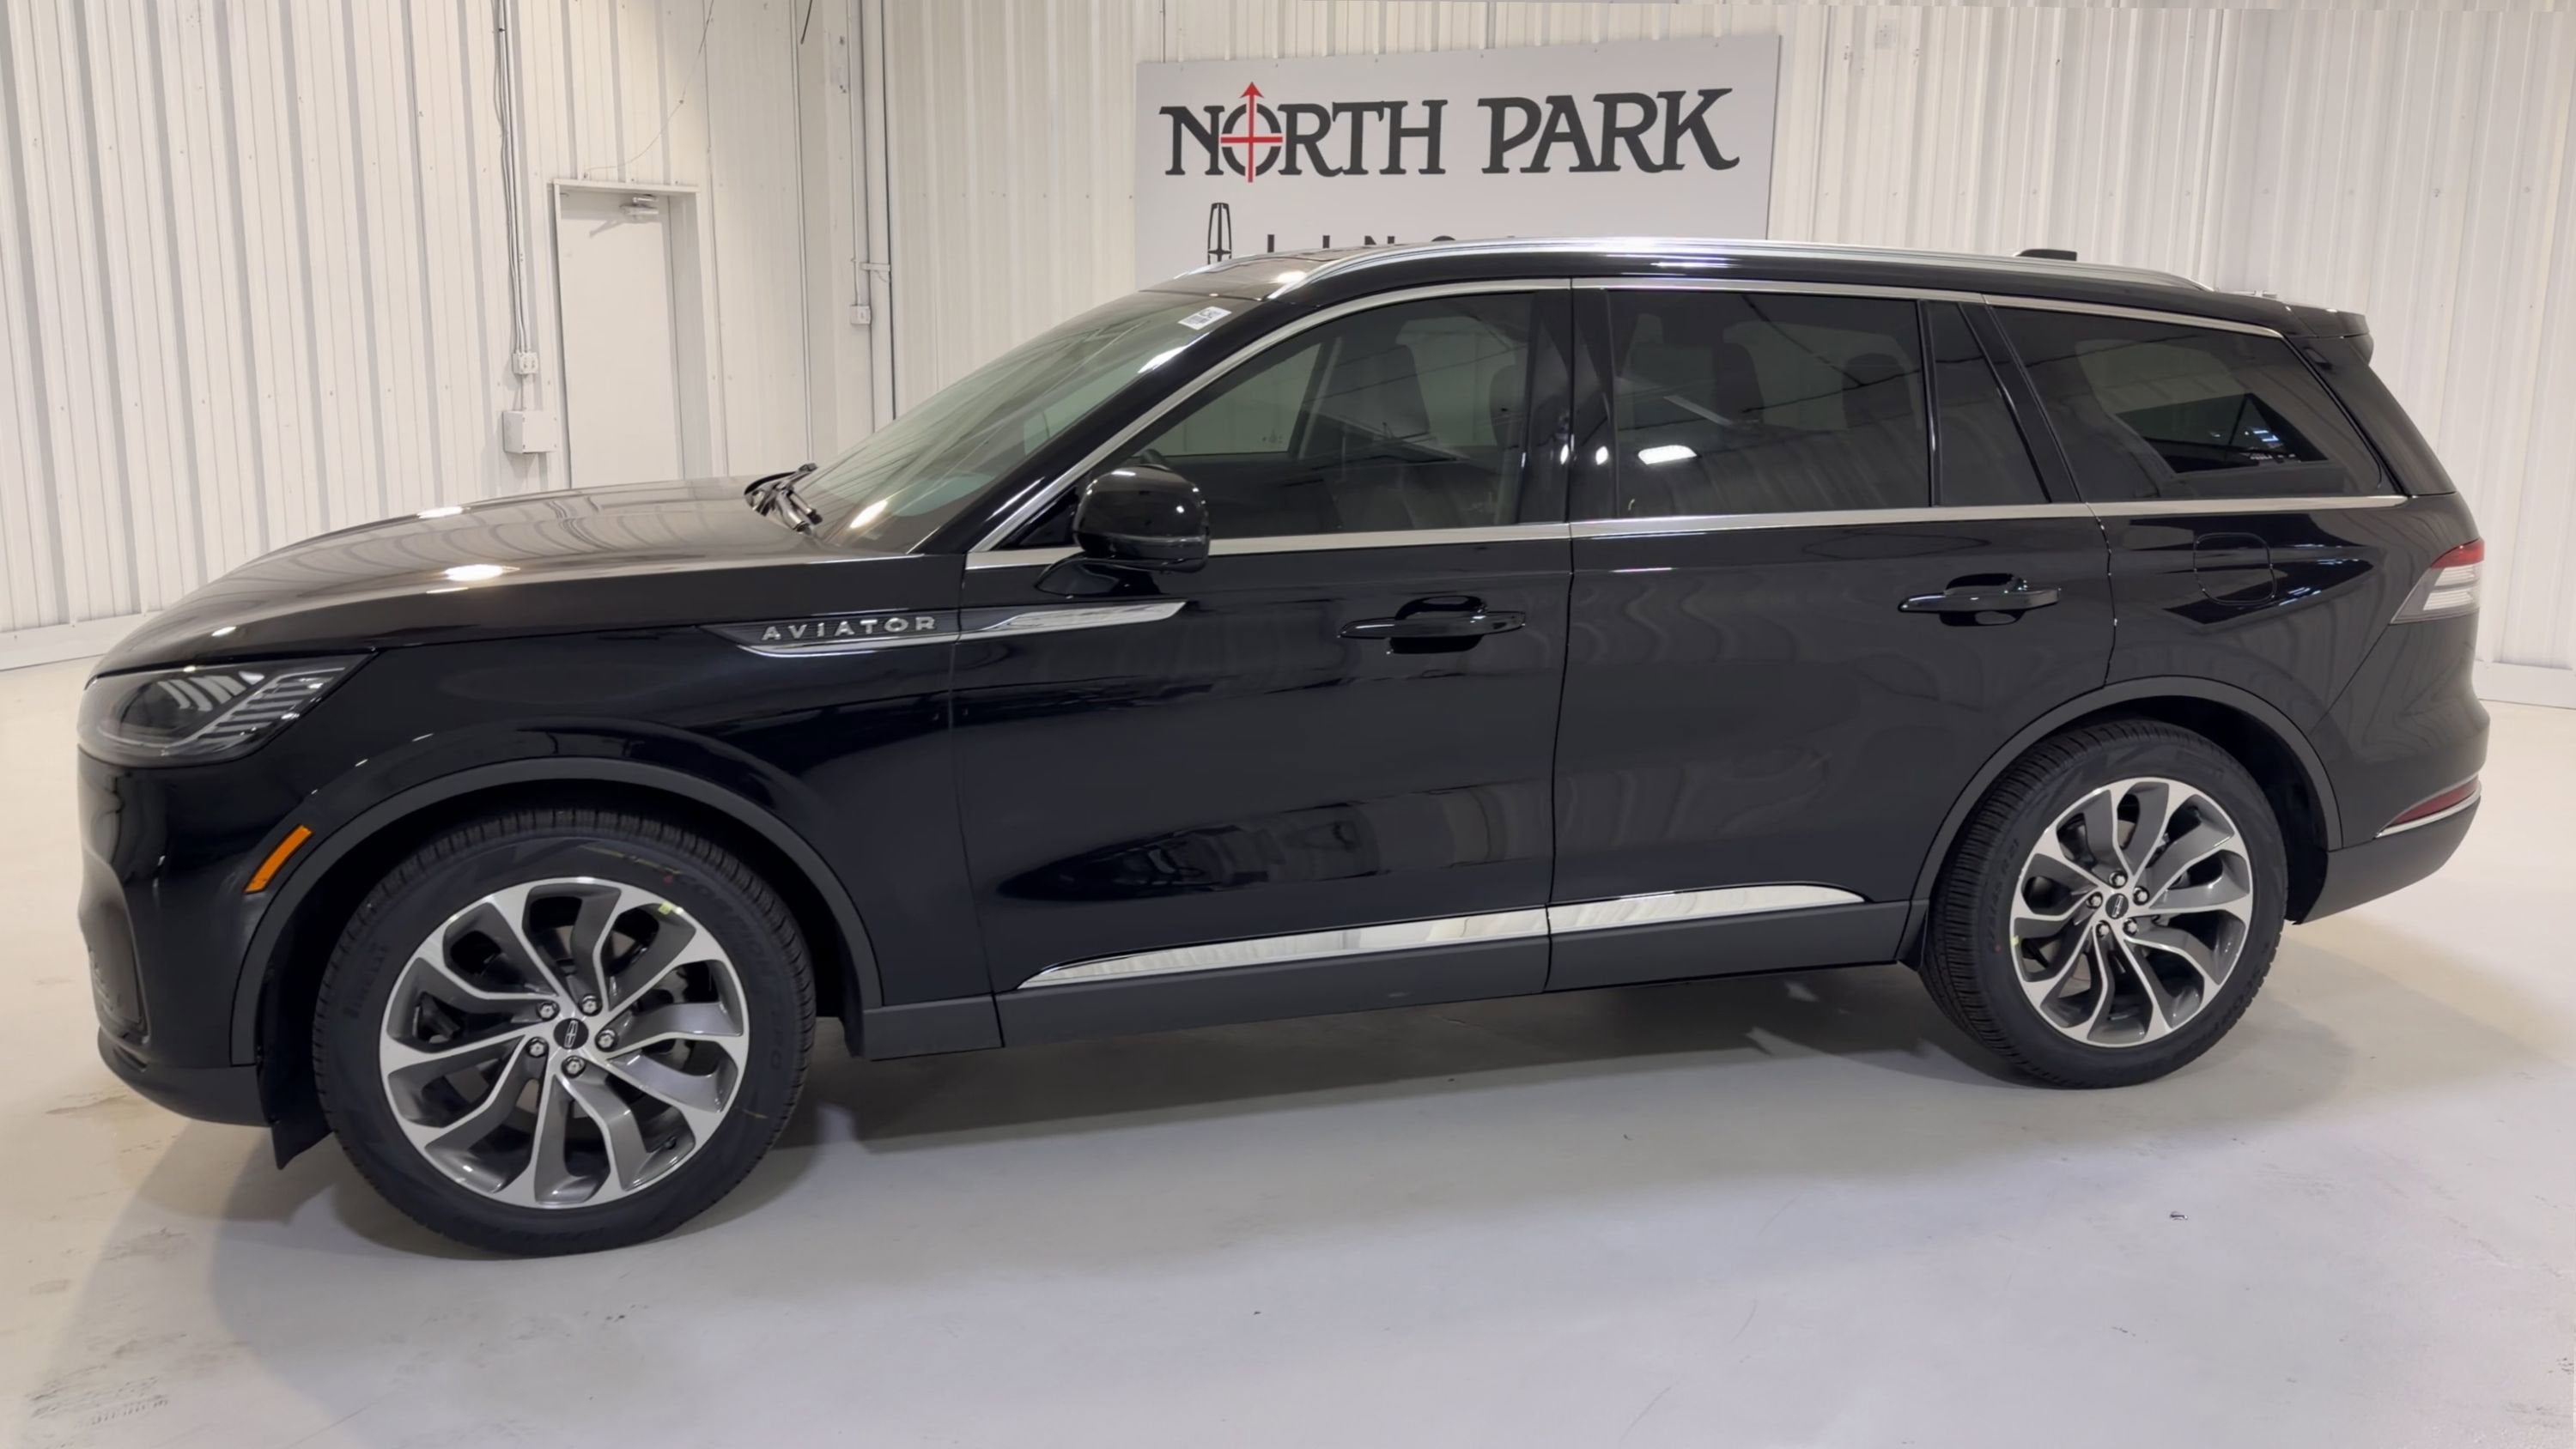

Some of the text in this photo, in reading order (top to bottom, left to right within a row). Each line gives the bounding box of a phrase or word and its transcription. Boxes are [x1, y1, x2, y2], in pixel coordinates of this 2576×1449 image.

[1159, 88, 1741, 177] NORTH PARK
[761, 615, 935, 641] AVIATOR
